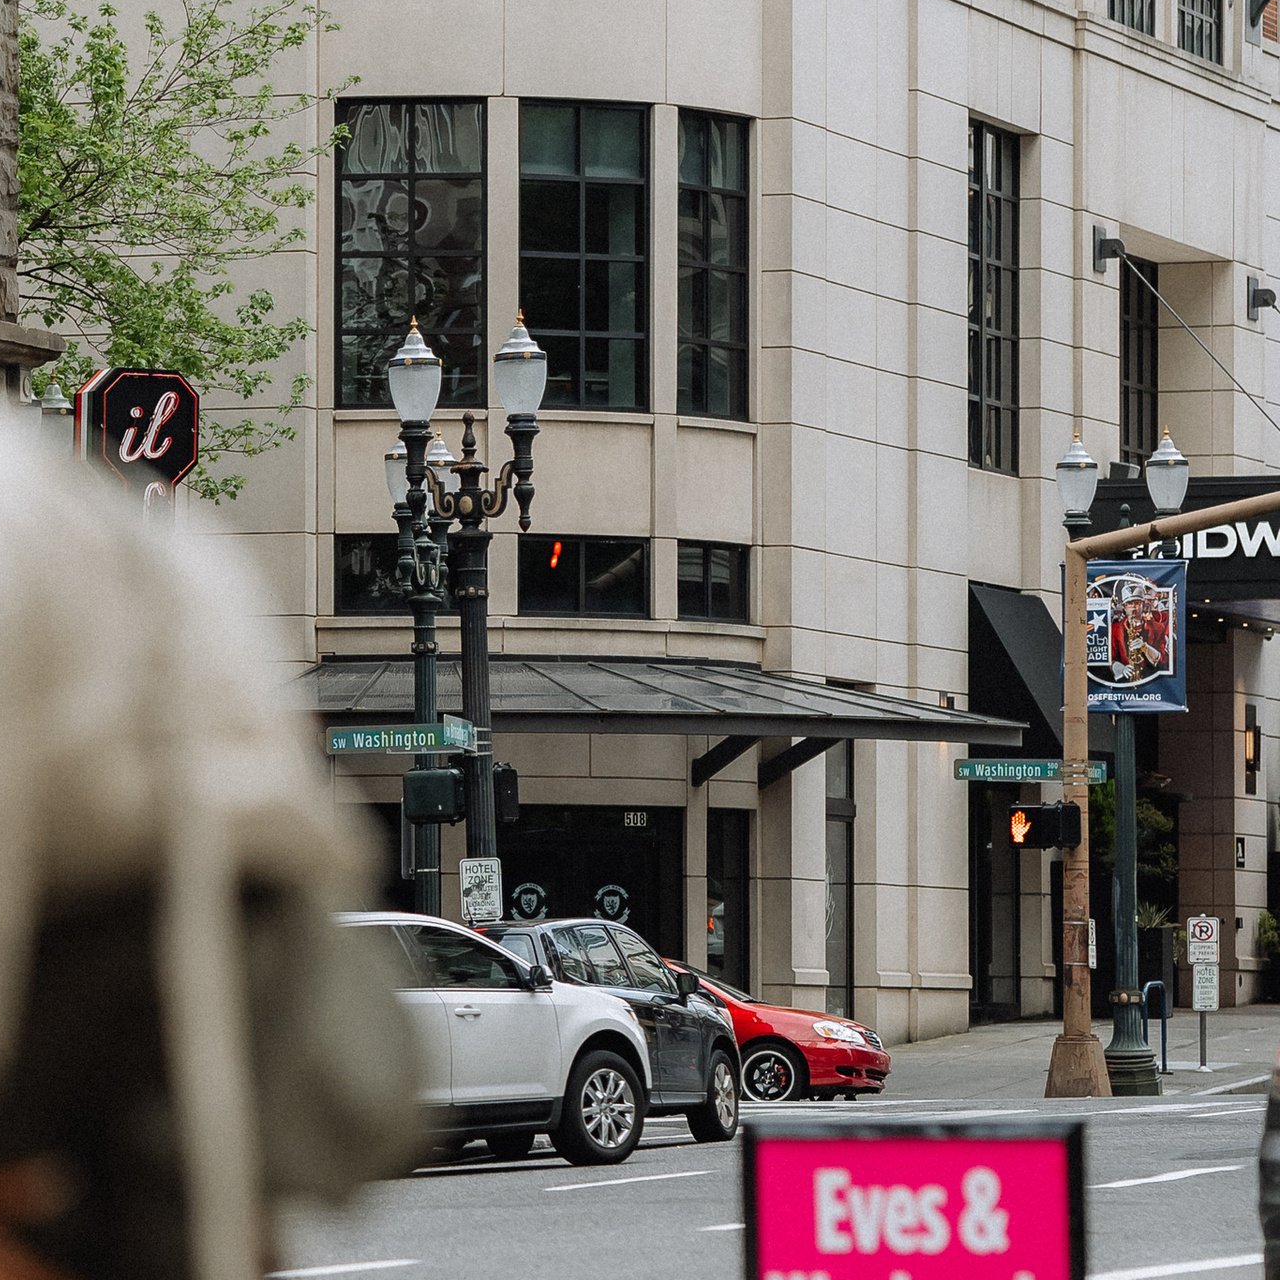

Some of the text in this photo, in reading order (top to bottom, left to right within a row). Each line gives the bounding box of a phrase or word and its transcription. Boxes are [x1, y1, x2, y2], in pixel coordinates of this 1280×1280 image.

[119, 391, 180, 463] il
[332, 731, 436, 751] SW Washington
[1047, 762, 1059, 770] 500
[958, 768, 970, 777] SW
[974, 764, 1041, 780] Washington
[625, 813, 644, 826] 508
[465, 864, 496, 874] HOTEL
[468, 875, 494, 885] ZONE
[1196, 968, 1216, 977] HOTEL
[1198, 976, 1215, 985] ZONE
[814, 1166, 1010, 1255] Eves &
